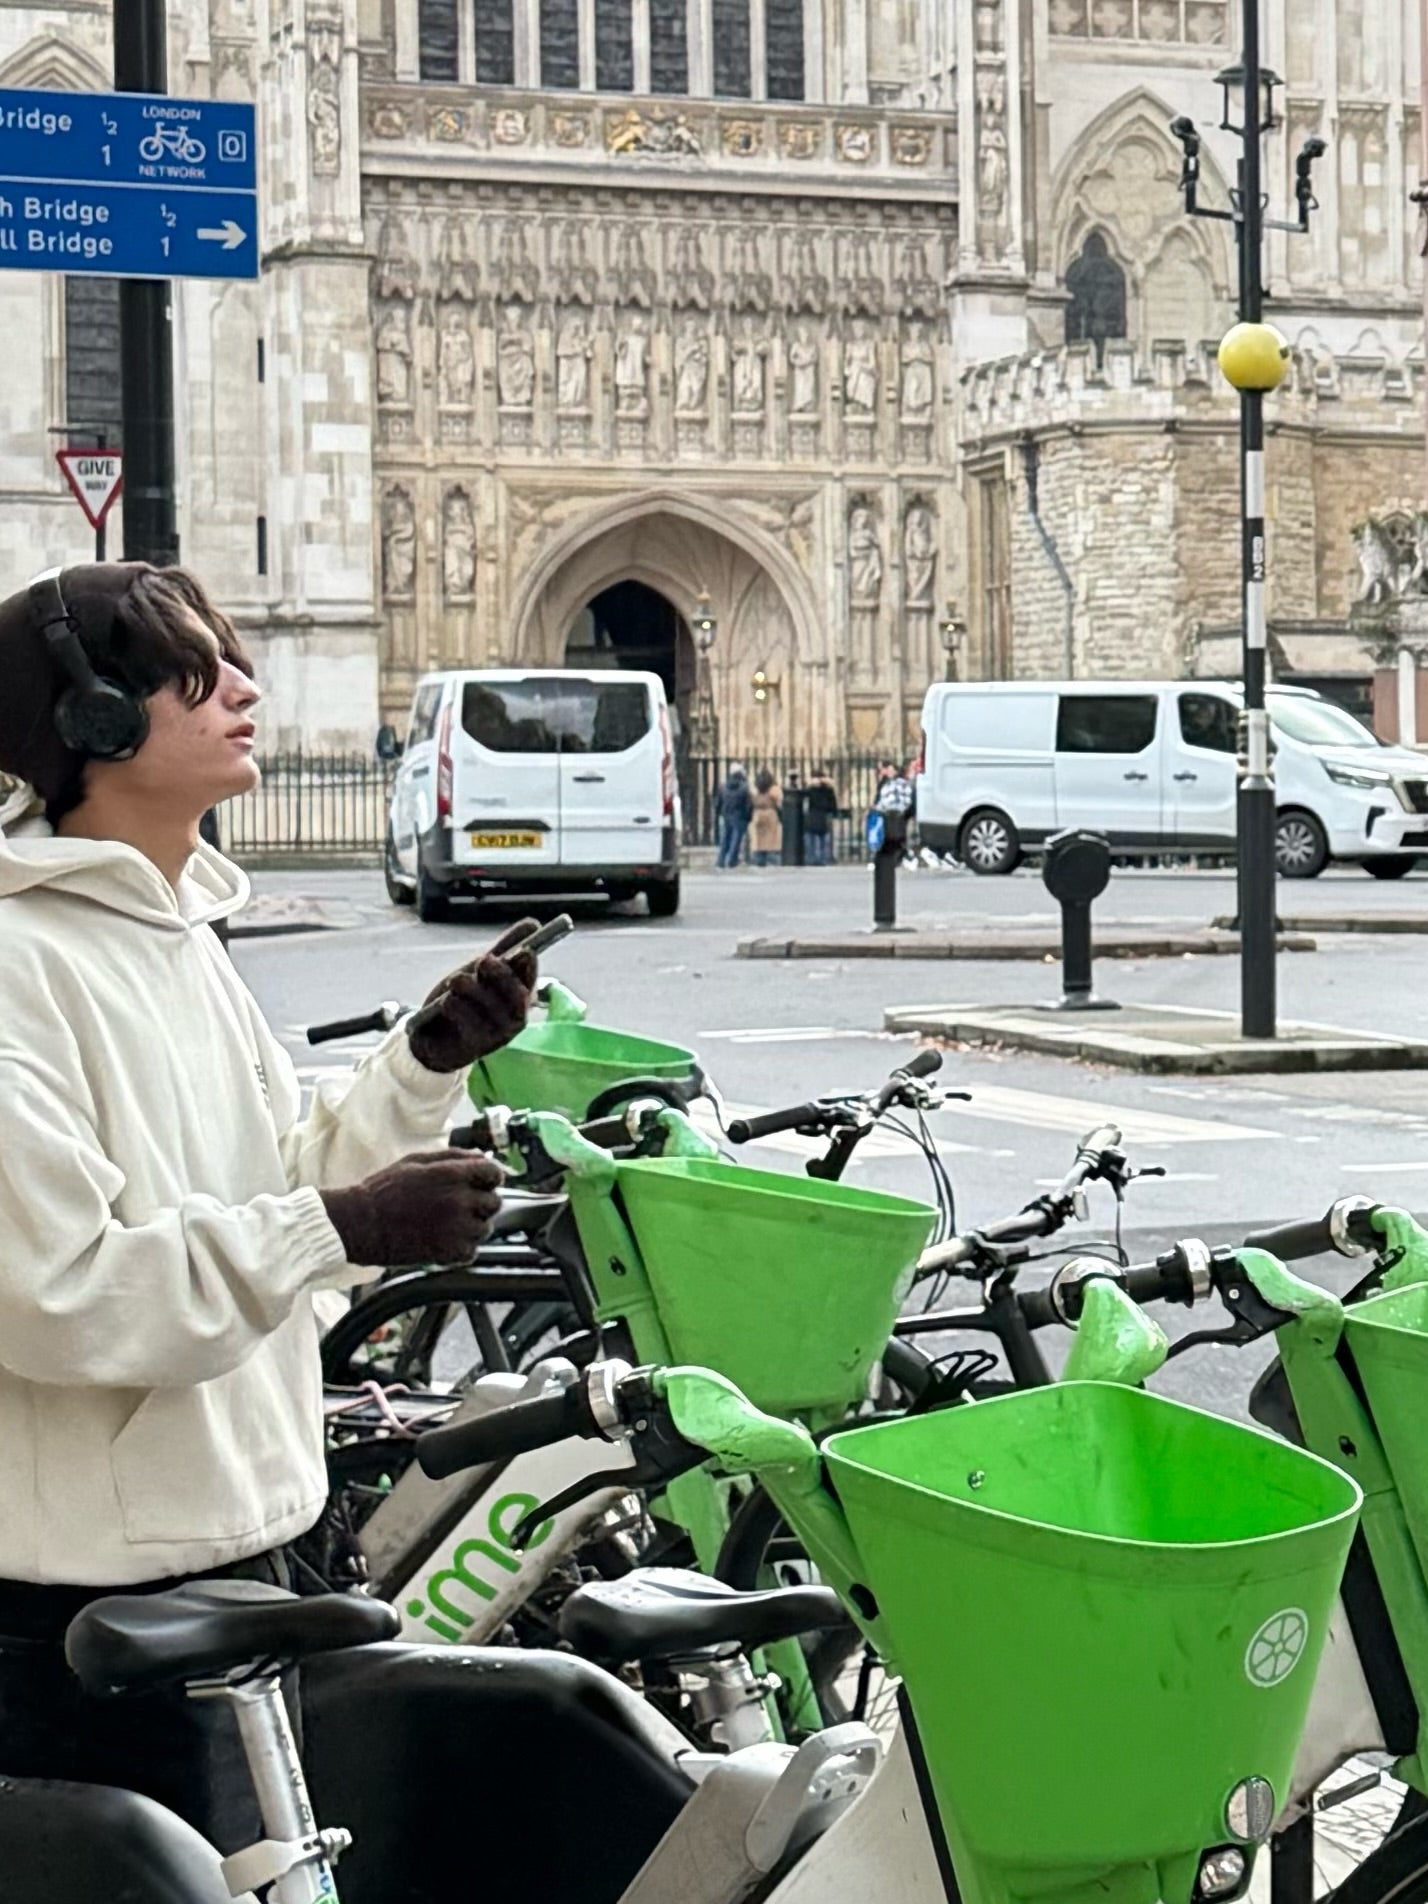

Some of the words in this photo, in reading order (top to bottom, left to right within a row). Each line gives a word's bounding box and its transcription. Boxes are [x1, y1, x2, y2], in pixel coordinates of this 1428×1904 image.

[0, 106, 73, 135] ridge
[141, 105, 202, 121] LONDON
[138, 164, 207, 180] NETWORK
[24, 196, 110, 227] Bridge
[28, 228, 114, 259] Bridge
[77, 459, 116, 477] GIVE
[405, 1491, 554, 1643] ime
